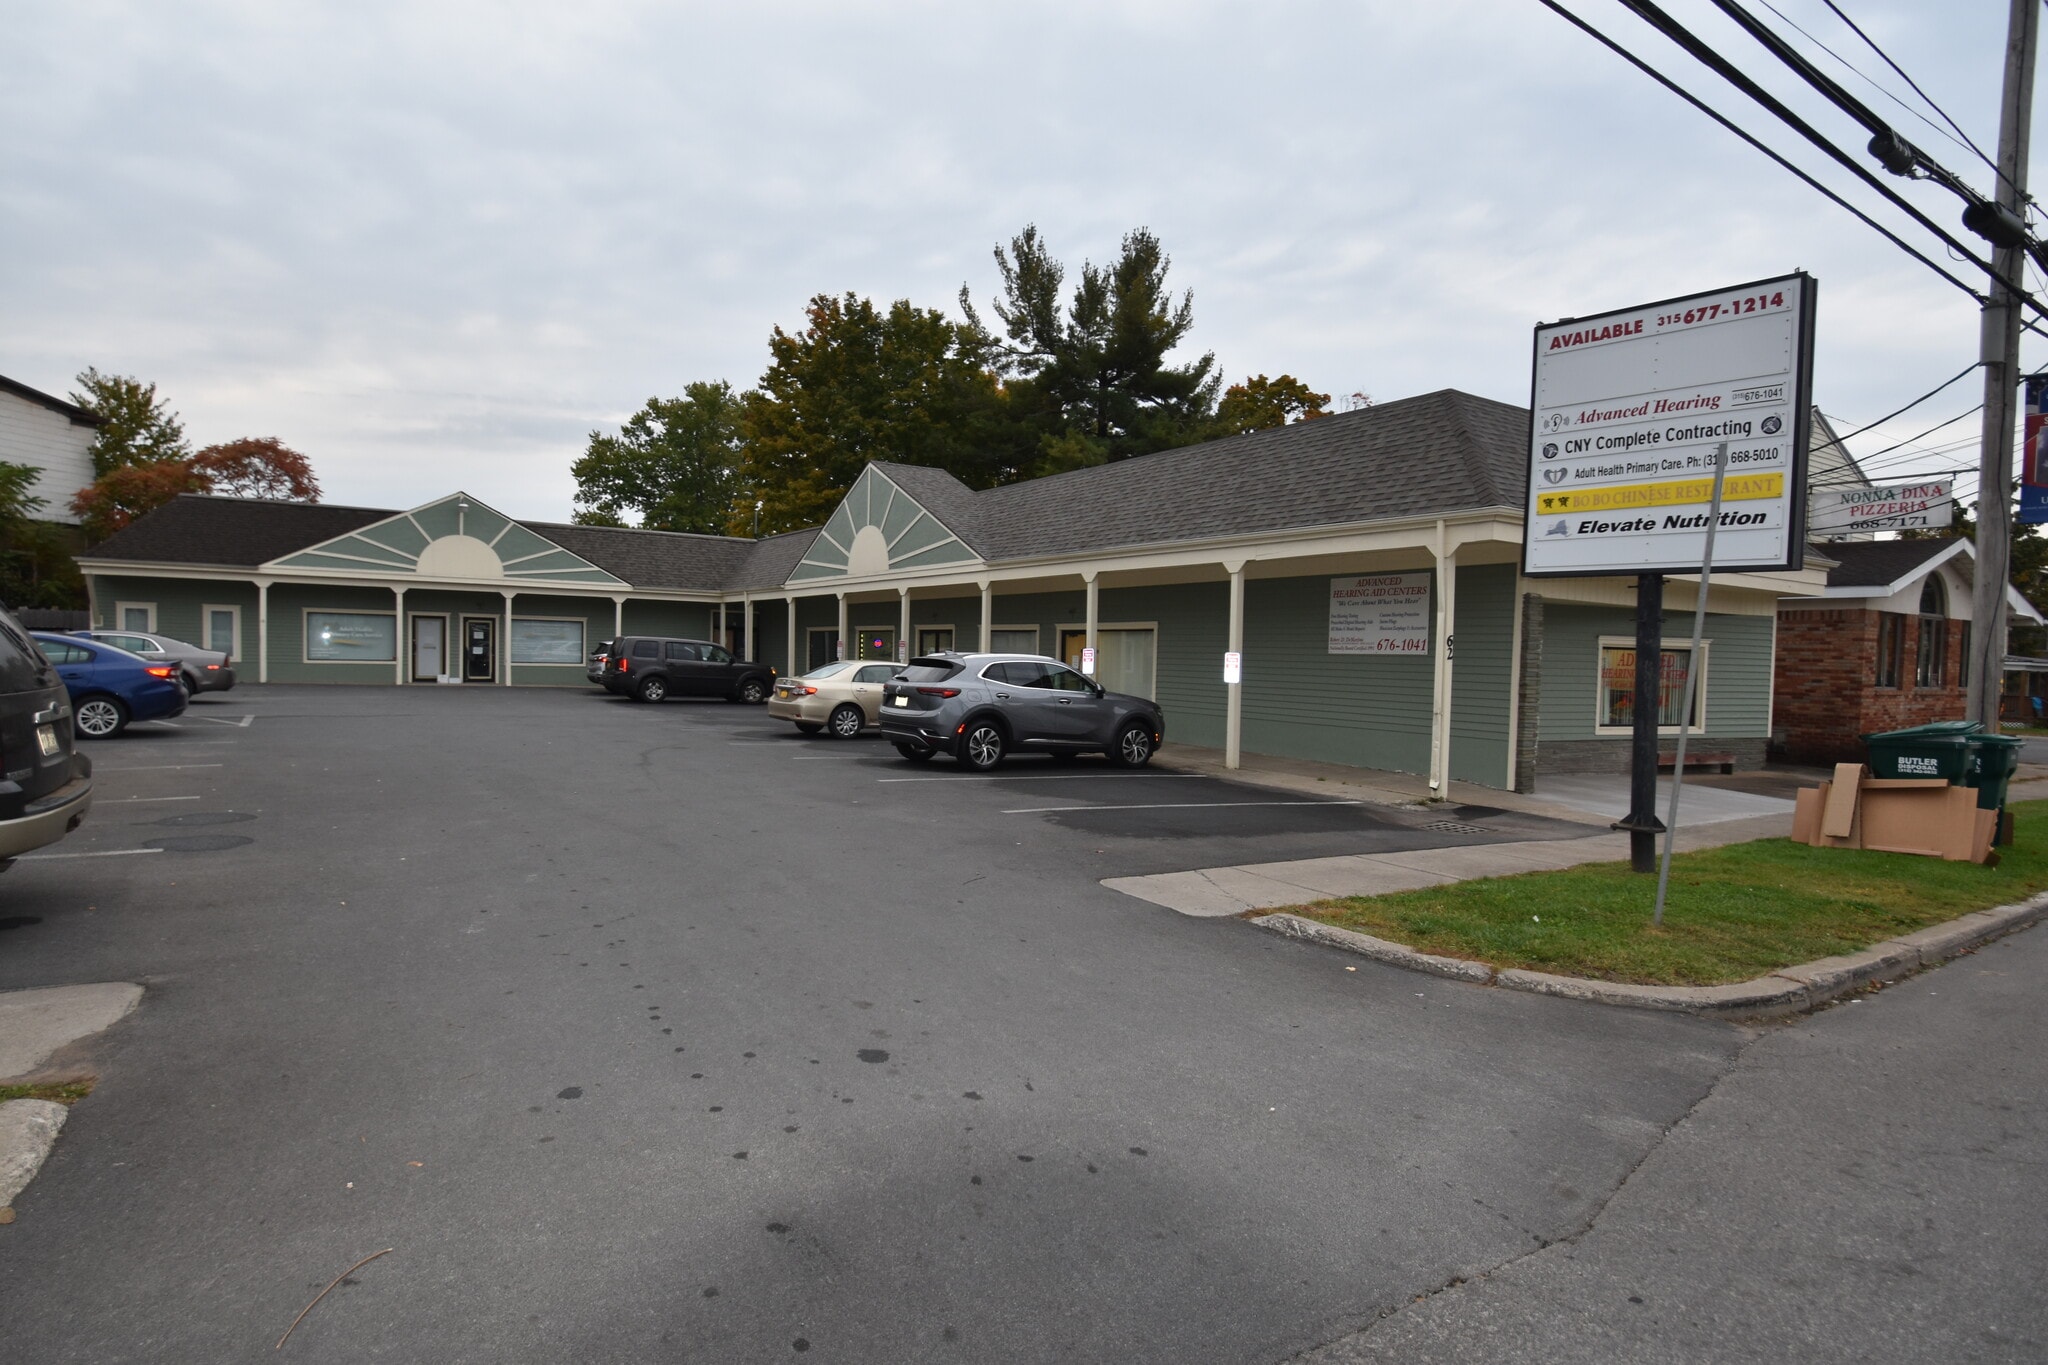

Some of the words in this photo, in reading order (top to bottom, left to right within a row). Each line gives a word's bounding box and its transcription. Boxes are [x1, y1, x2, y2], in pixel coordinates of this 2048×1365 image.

[1550, 319, 1644, 350] AVAILABLE
[1657, 313, 1681, 327] 315
[1683, 292, 1784, 325] 677-1214
[1574, 402, 1650, 425] Advanced
[1653, 394, 1721, 415] Hearing
[1565, 438, 1591, 454] CNY
[1596, 428, 1661, 450] Complete
[1666, 420, 1752, 442] Contracting
[1574, 467, 1596, 480] Adult
[1598, 463, 1624, 477] Health
[1627, 460, 1659, 476] Primary
[1661, 459, 1685, 472] Care.
[1687, 456, 1701, 468] Ph:
[1703, 454, 1728, 469] (31)
[1731, 447, 1779, 463] 668-5010
[1573, 495, 1589, 508] BO
[1593, 493, 1611, 506] BO
[1613, 487, 1671, 505] CHINESE
[1840, 489, 1896, 504] NONNA
[1902, 485, 1943, 499] DINA
[1850, 500, 1929, 517] PIZZERIA
[1577, 517, 1657, 534] Elevate
[1850, 516, 1928, 530] 668-7171
[1356, 577, 1402, 588] ADVANCED
[1333, 588, 1369, 599] HEARING
[1370, 587, 1386, 597] AID
[1387, 586, 1428, 596] CENTERS
[1376, 638, 1427, 651] 676-1041
[1898, 756, 1938, 766] BUTLER
